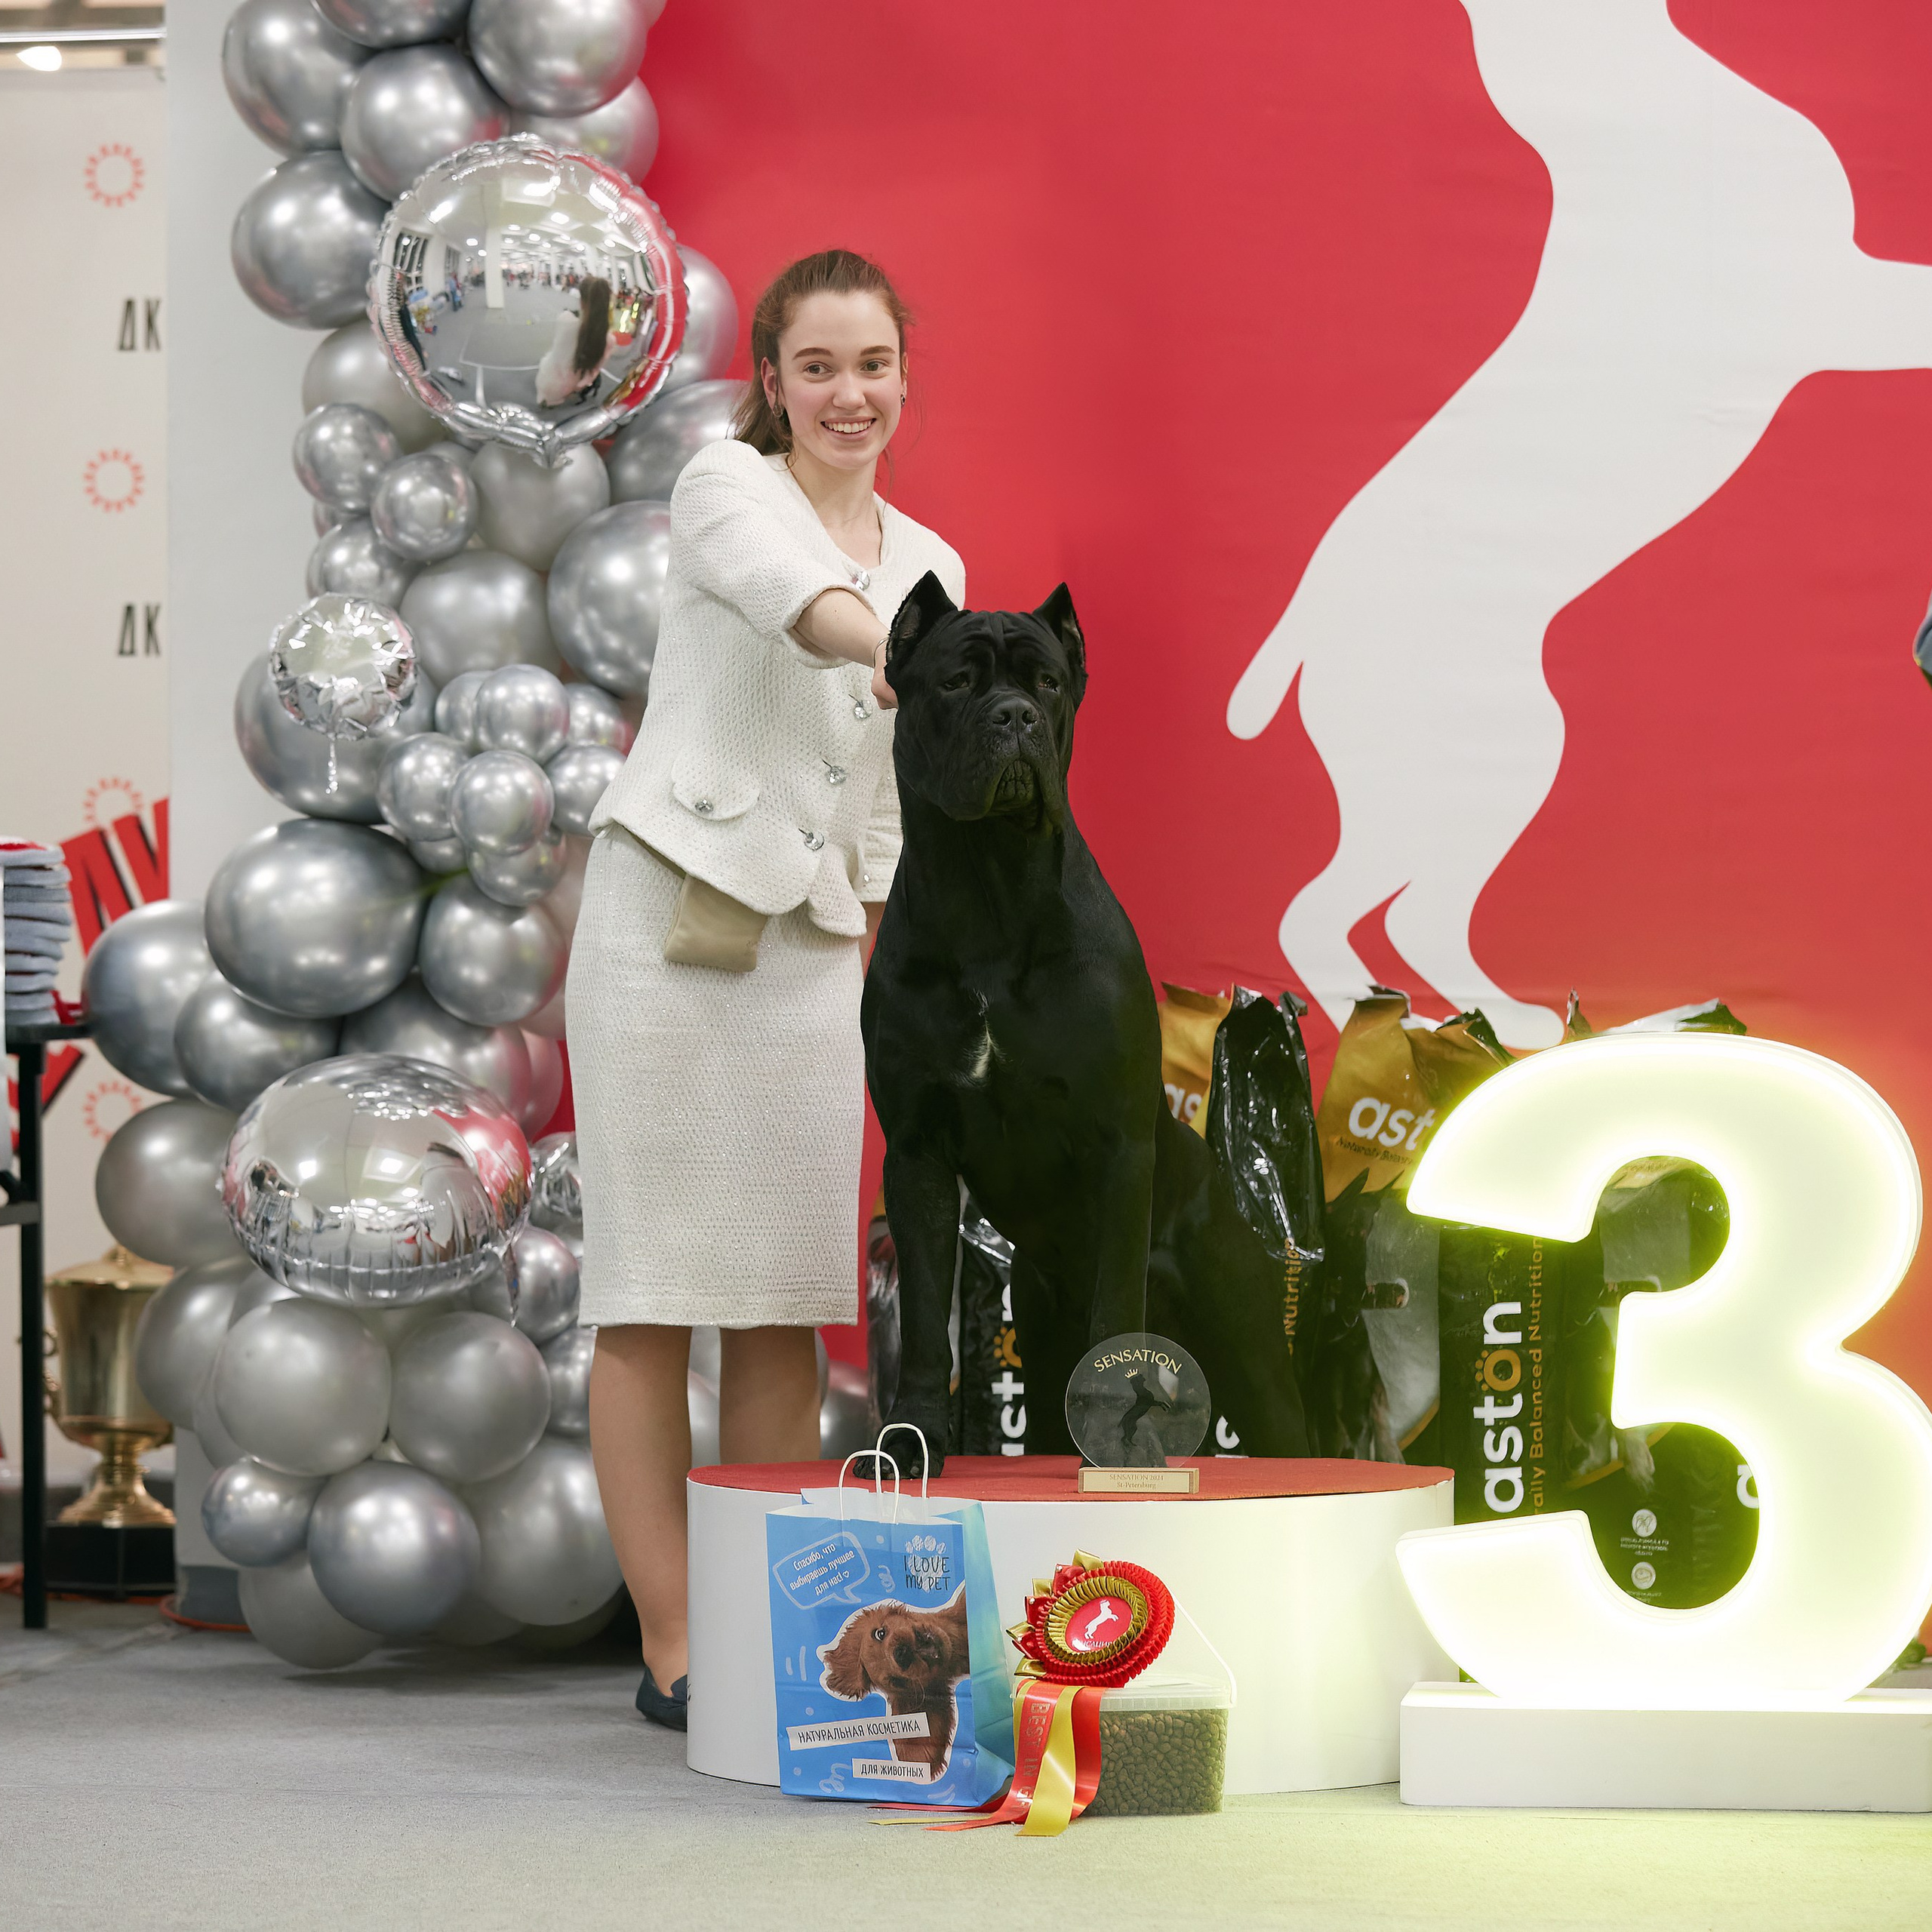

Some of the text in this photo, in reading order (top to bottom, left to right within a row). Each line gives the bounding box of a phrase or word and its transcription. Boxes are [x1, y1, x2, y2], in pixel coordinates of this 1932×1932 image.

[1094, 1349, 1183, 1374] SENSATION
[1395, 1032, 1932, 1709] 3
[1529, 1349, 1544, 1459] Balanced
[793, 1543, 836, 1571] Спасибо, что
[903, 1555, 950, 1573] I LOVE
[789, 1549, 855, 1591] выбираешь лучшее
[814, 1573, 844, 1596] для нас!
[928, 1577, 951, 1591] PET
[797, 1719, 921, 1744] НАТУРАЛЬНАЯ КОСМЕТИКА
[1026, 1703, 1051, 1747] BEST
[860, 1763, 924, 1778] ДЛЯ ЖИВОТНЫХ
